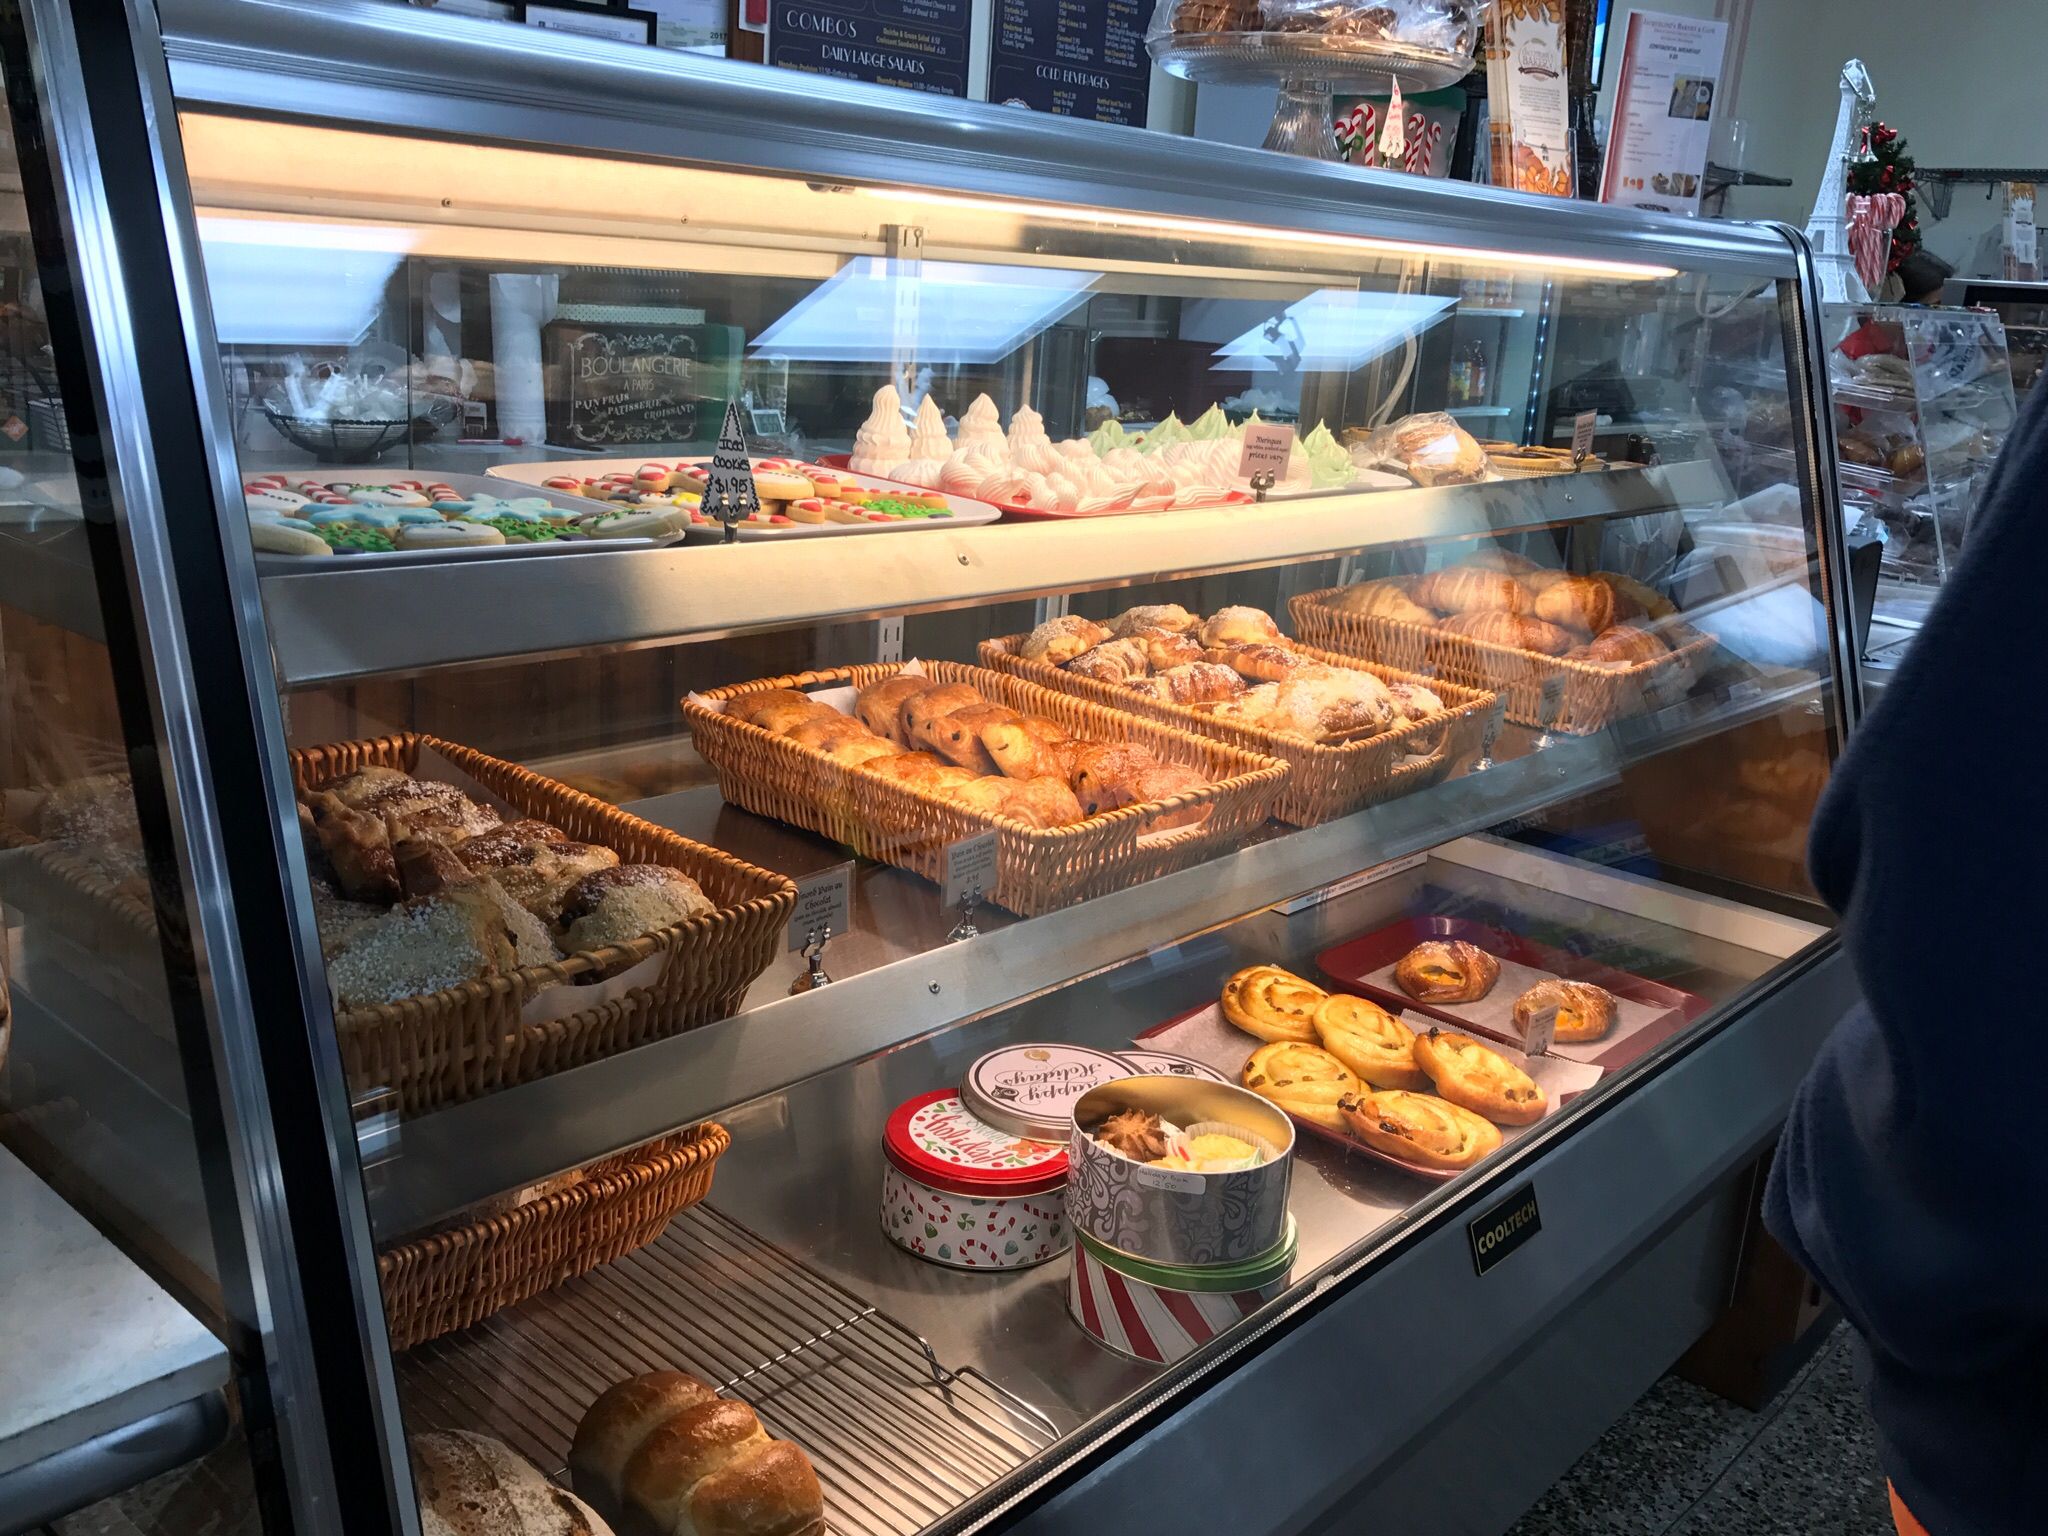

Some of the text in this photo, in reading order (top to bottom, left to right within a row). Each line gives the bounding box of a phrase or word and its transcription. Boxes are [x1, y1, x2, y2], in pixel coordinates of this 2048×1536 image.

[786, 10, 857, 38] COMBOS
[821, 44, 925, 75] DAILY LARGE SALADS
[1063, 70, 1110, 90] BEVERAGES
[580, 356, 692, 378] BOULANGERIE
[632, 379, 655, 391] PARIS
[575, 393, 630, 410] PAIN FRAIS
[607, 399, 662, 416] PATISSERIE
[715, 477, 748, 494] $1.95
[998, 1062, 1102, 1086] Holidays
[1019, 1082, 1099, 1105] appy
[924, 1112, 1014, 1164] holiday
[1478, 1200, 1537, 1254] COOLTECH
